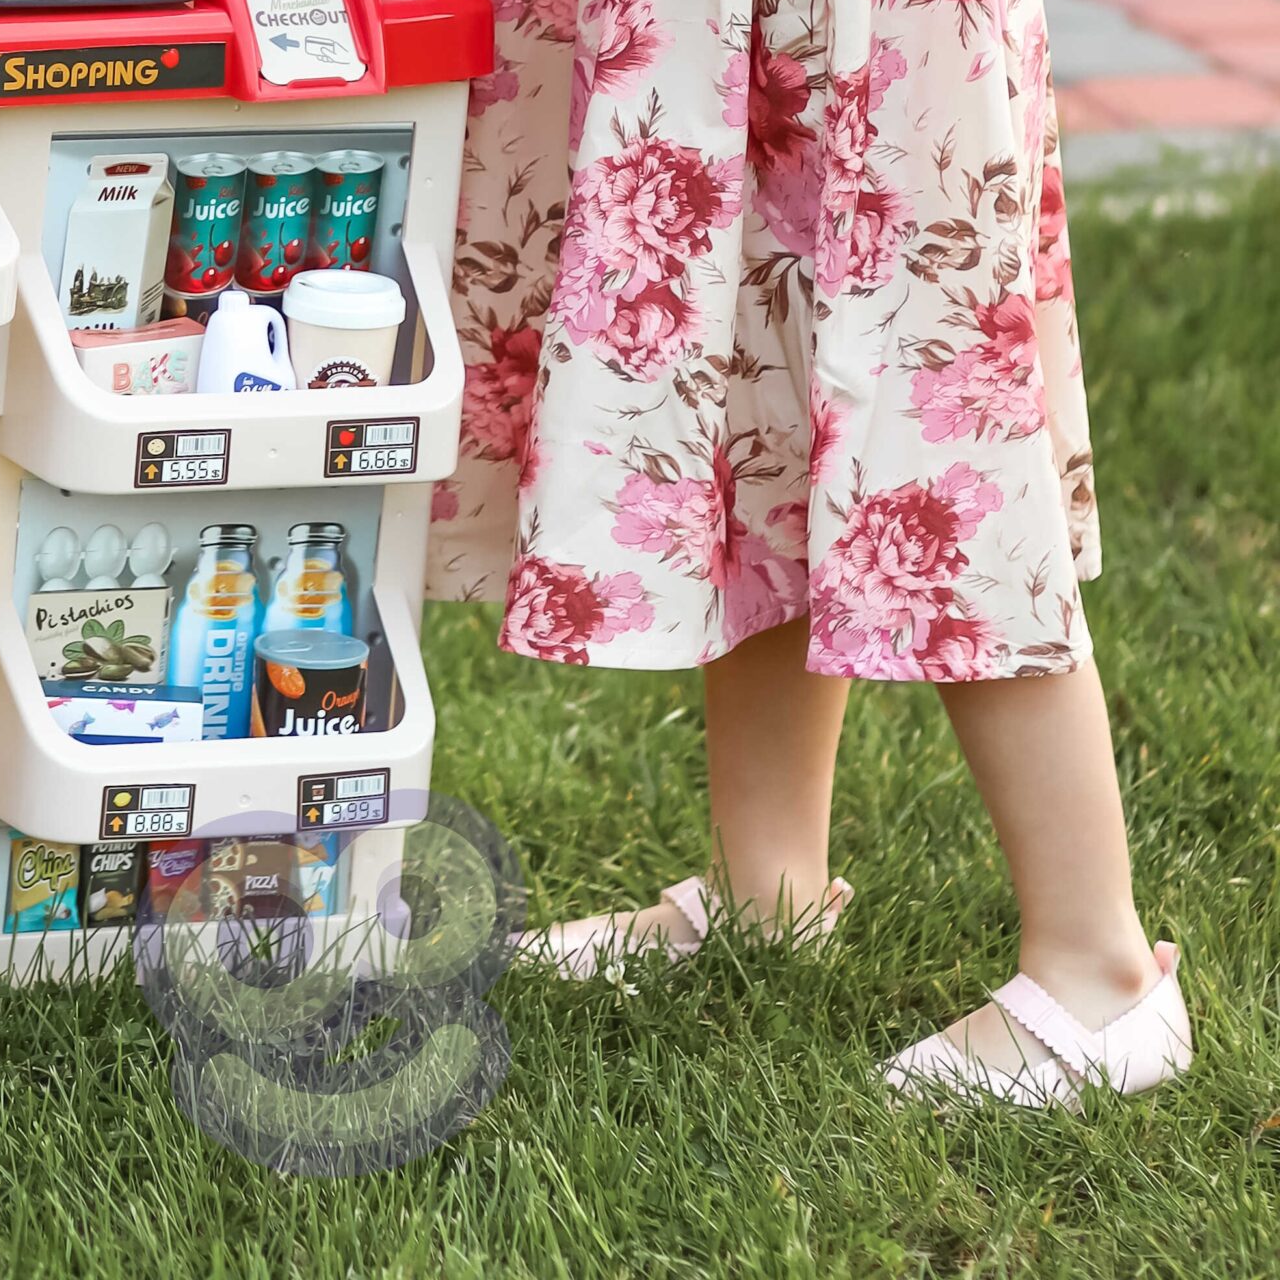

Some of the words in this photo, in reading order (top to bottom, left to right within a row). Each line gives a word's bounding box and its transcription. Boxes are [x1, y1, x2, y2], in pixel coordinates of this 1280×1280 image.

[255, 8, 348, 27] CHECKOUT
[3, 57, 159, 91] SHOPPING
[98, 185, 138, 202] Milk
[183, 196, 240, 221] Juice
[253, 196, 310, 219] Juice
[320, 195, 377, 217] Juice
[35, 594, 135, 631] Pistachios
[232, 631, 248, 692] orange
[81, 685, 157, 695] CANDY
[17, 842, 75, 893] Chips
[91, 852, 135, 873] CHIPS
[245, 874, 279, 890] PIZZA
